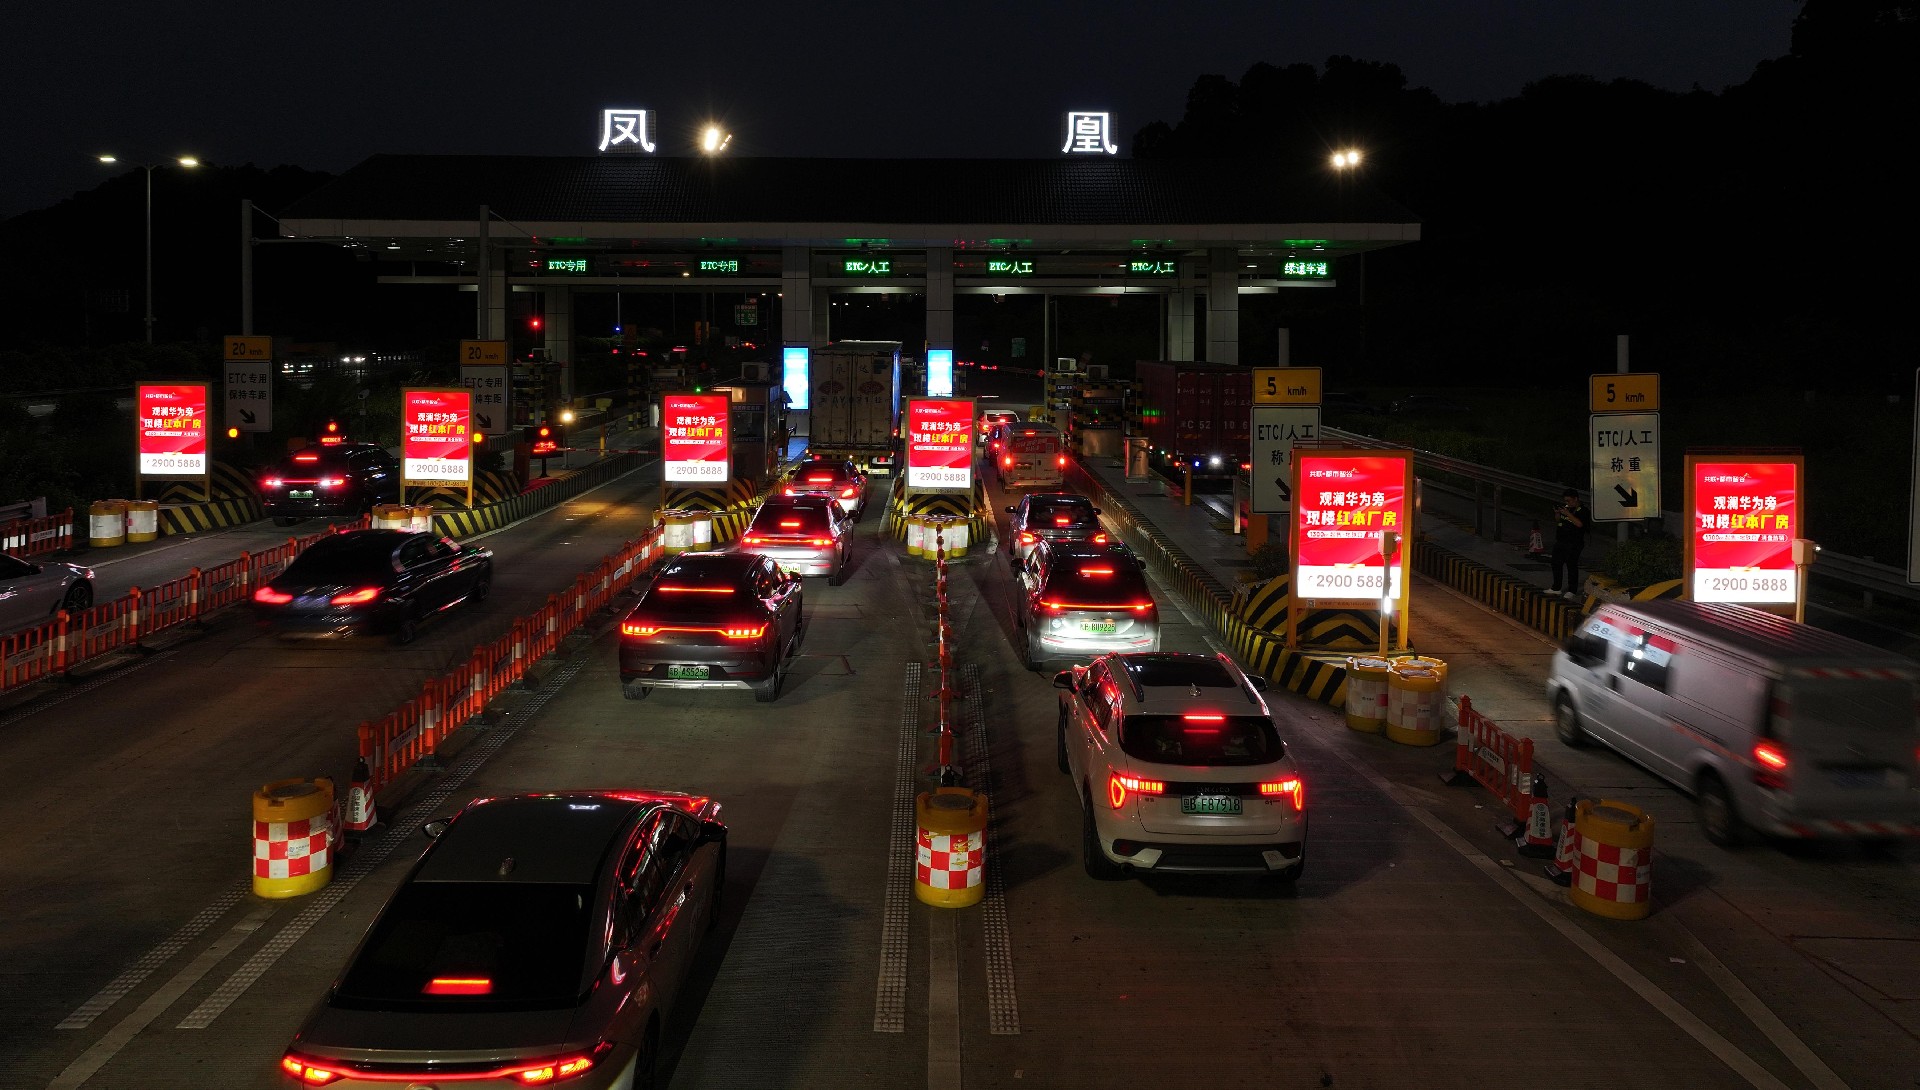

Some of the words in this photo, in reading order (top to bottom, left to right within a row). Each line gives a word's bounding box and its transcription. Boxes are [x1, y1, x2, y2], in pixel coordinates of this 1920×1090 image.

[599, 109, 656, 153] 凤
[1062, 112, 1118, 155] 凰
[548, 260, 587, 272] ETC专用
[845, 260, 890, 274] ETC/人工
[989, 260, 1033, 274] ETC/人工
[1131, 261, 1175, 274] ETC/人工
[1284, 261, 1328, 276] 绿通车道
[232, 342, 246, 356] 20
[468, 346, 482, 360] 20
[1267, 376, 1277, 396] 5
[1287, 386, 1307, 396] km/h
[1606, 383, 1616, 402] 5
[1625, 392, 1645, 403] km/h
[229, 389, 267, 400] 保持车距
[475, 393, 502, 405] 持车距
[151, 458, 175, 468] 2900
[177, 459, 201, 468] 5888
[416, 464, 439, 473] 2900
[441, 465, 464, 474] 5888
[676, 466, 698, 475] 2900
[700, 466, 723, 475] 5888
[920, 472, 942, 481] 2900
[943, 473, 966, 482] 5888
[1319, 491, 1385, 507] 观澜华为旁
[1713, 495, 1777, 511] 观澜华为旁
[1306, 510, 1397, 526] 现楼红本厂房
[1701, 514, 1789, 530] 现楼红本厂房
[1316, 574, 1353, 588] 2900
[1712, 577, 1748, 591] 2900
[1752, 578, 1788, 592] 5888
